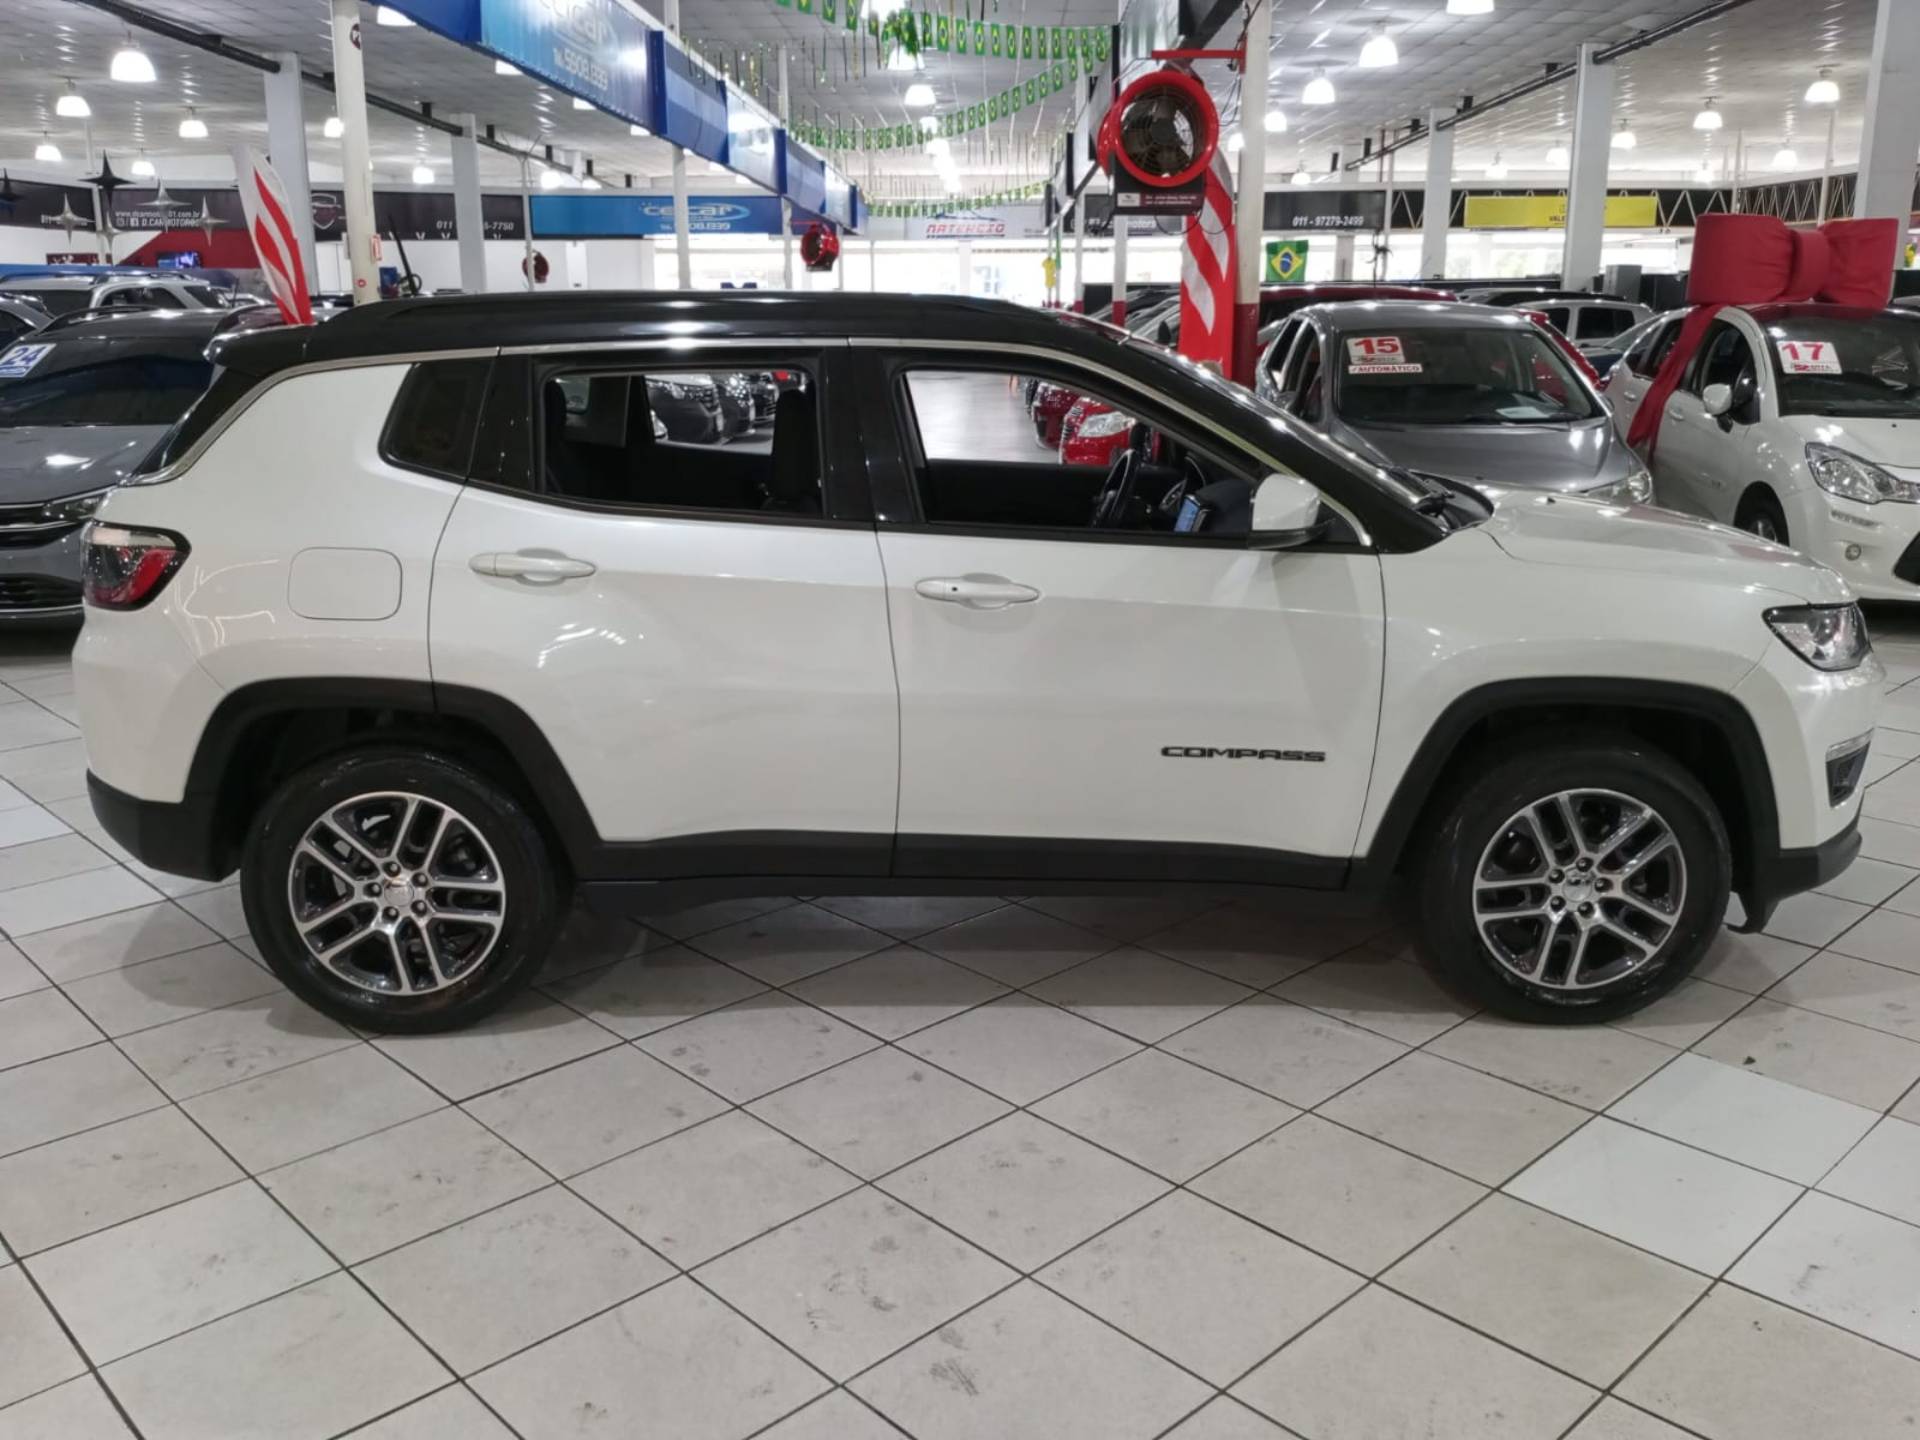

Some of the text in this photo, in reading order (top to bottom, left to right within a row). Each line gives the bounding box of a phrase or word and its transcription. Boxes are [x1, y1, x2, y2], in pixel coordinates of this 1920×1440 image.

[436, 220, 453, 230] 011
[1292, 216, 1309, 227] 011
[1354, 338, 1399, 355] 15
[1782, 343, 1824, 361] 17
[1, 346, 47, 366] 24
[1161, 746, 1326, 762] COMPASS
